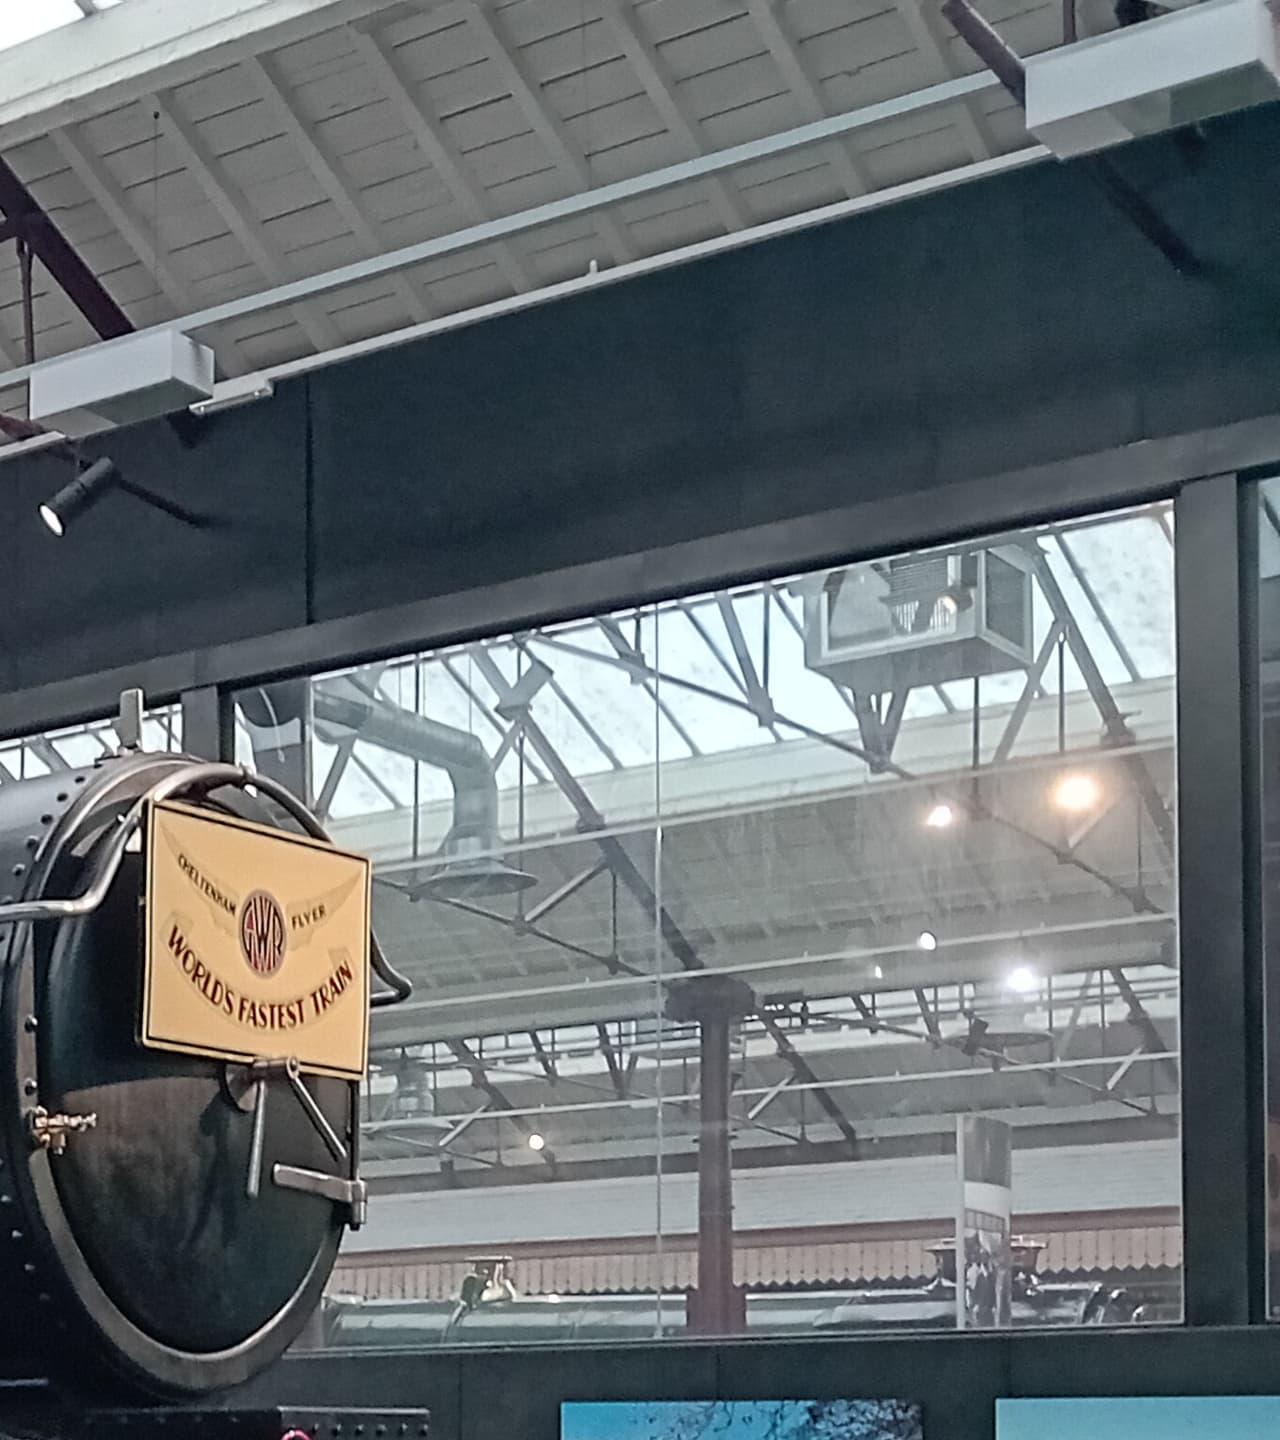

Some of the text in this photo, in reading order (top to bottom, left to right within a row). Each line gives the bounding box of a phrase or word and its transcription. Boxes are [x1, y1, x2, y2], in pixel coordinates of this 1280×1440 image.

[178, 854, 327, 931] CHELTENHAM FLYER
[241, 895, 284, 974] GWR
[238, 997, 305, 1029] FASTEST
[310, 960, 353, 1016] TRAIN
